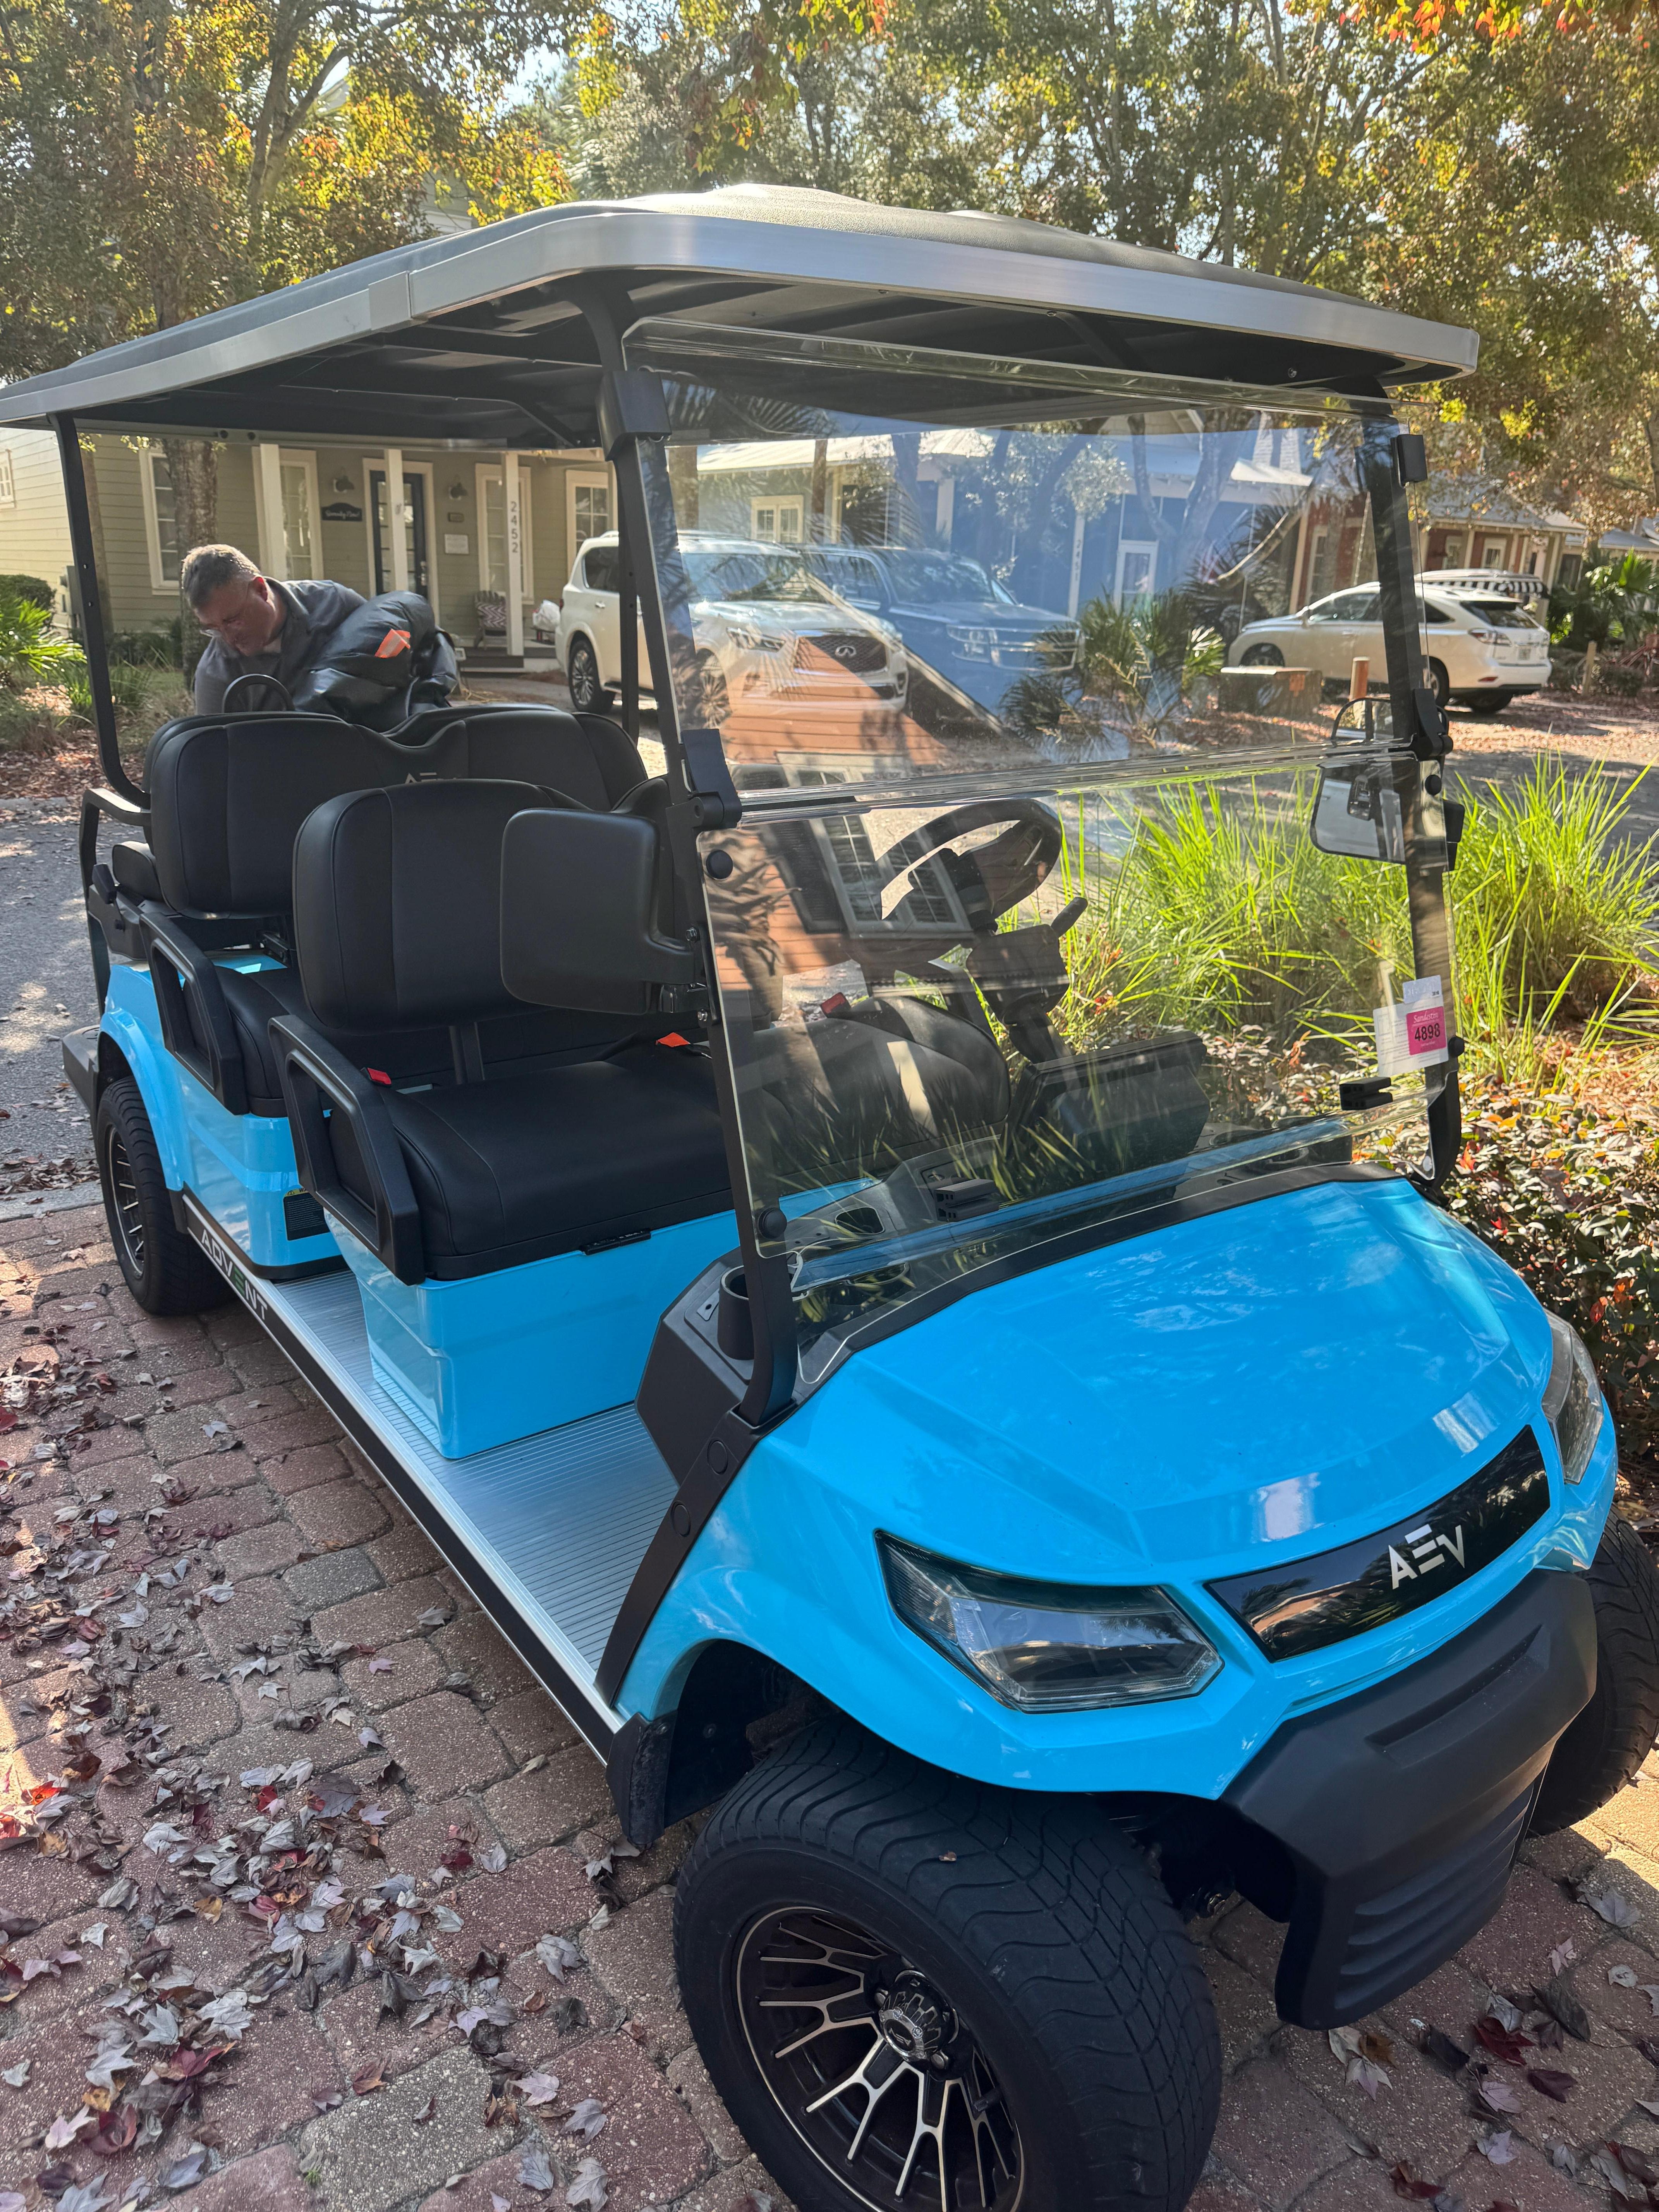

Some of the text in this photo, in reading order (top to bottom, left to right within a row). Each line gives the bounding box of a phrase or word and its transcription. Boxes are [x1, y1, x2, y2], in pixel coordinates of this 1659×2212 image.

[1415, 1023, 1440, 1041] 4898
[201, 1229, 268, 1320] ADVENT
[1388, 1524, 1465, 1590] AEV
